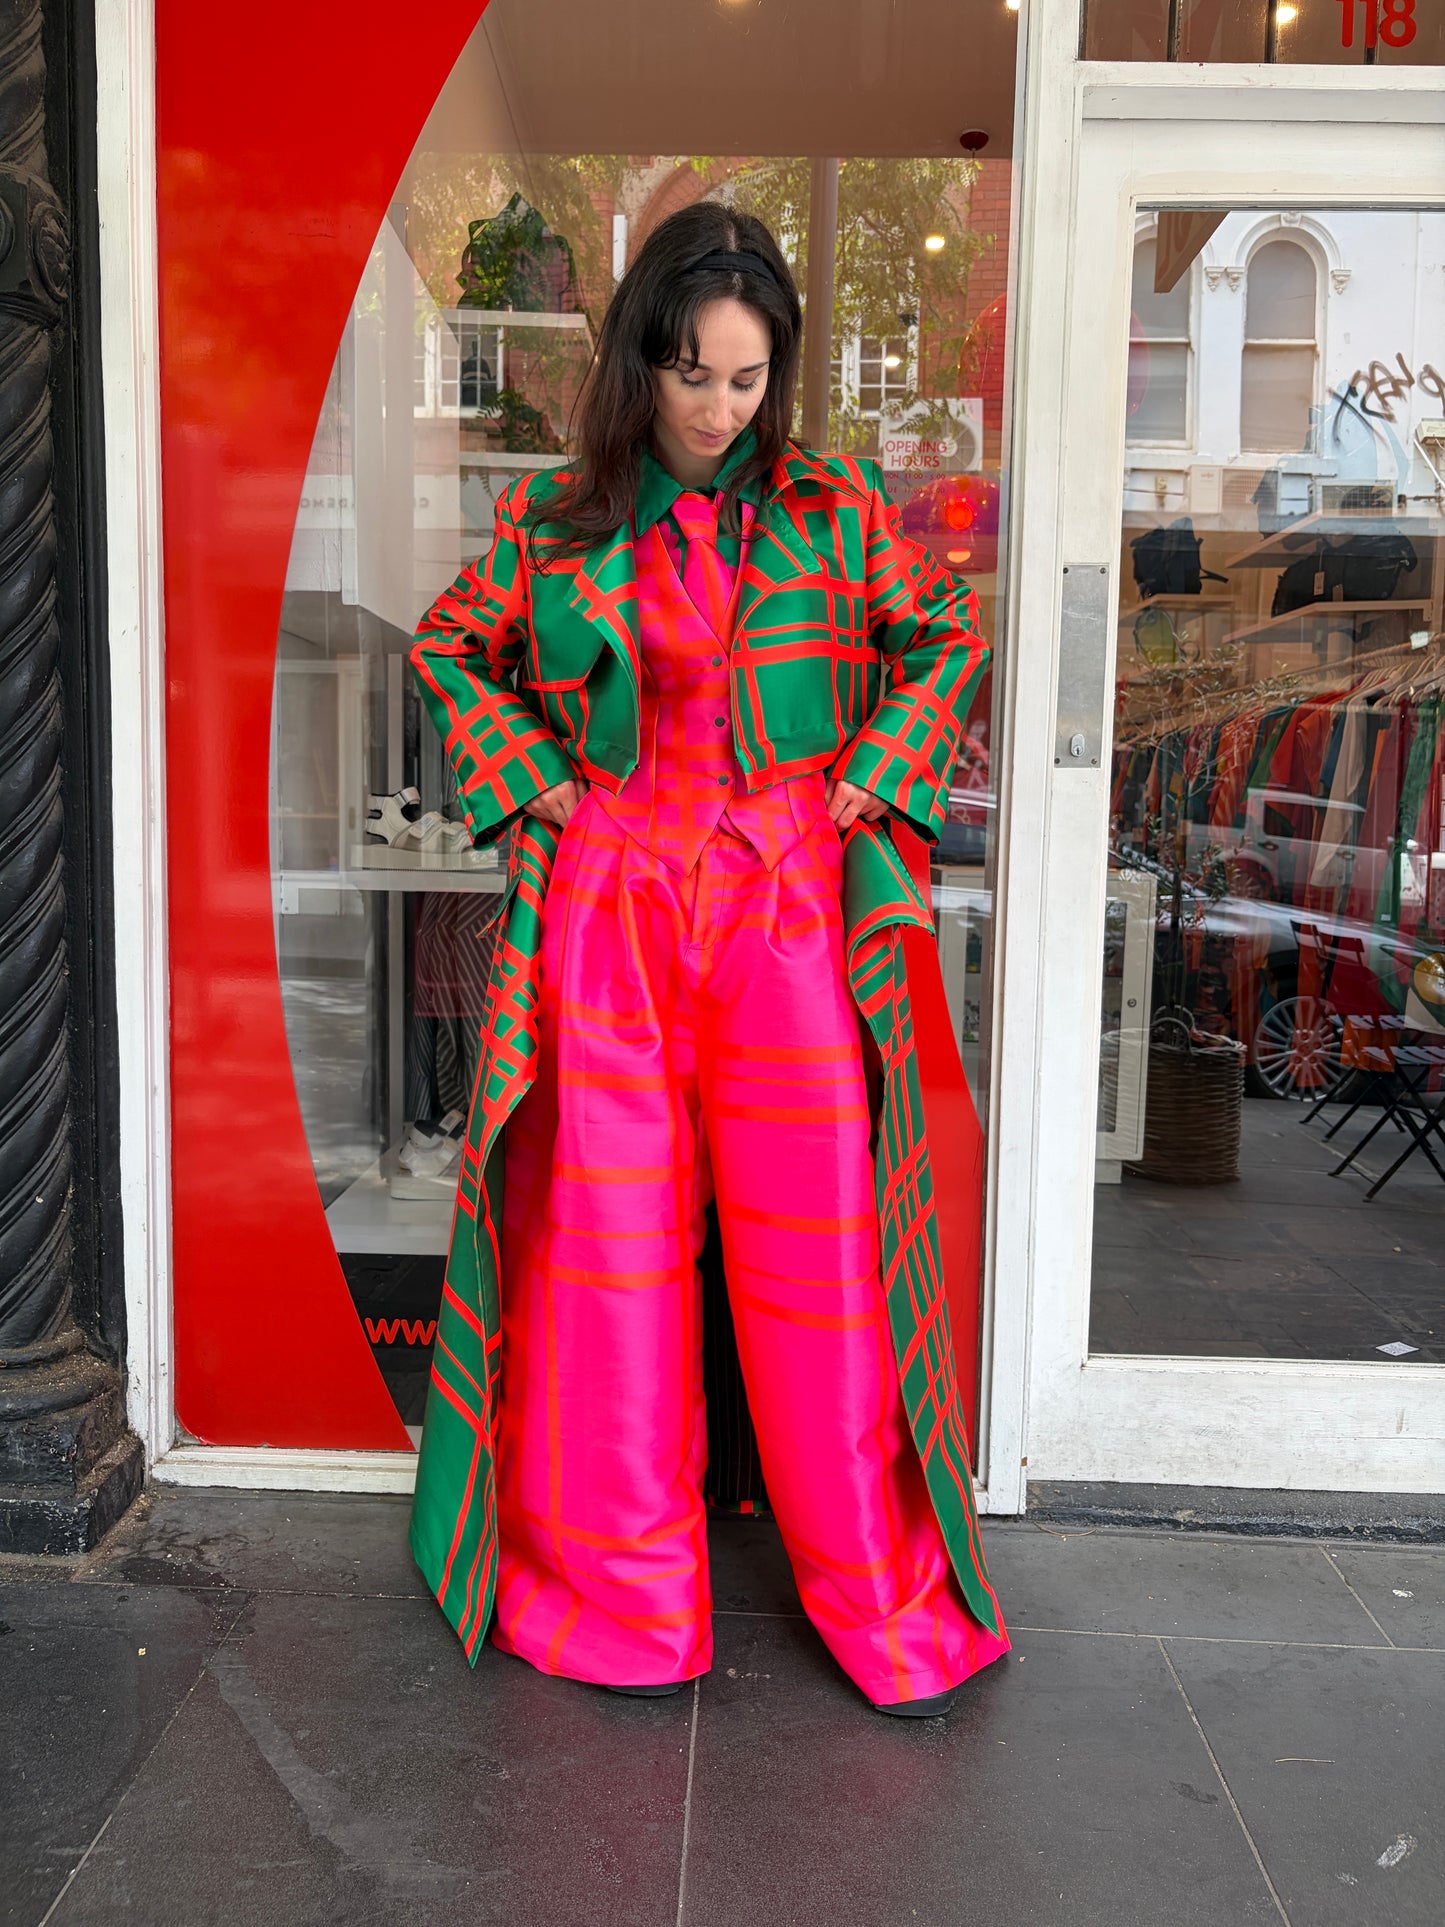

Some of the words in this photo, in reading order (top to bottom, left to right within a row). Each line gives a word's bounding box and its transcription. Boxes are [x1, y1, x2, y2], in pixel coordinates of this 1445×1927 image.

[1336, 0, 1417, 48] 118
[885, 440, 948, 454] OPENING
[891, 455, 940, 468] HOURS
